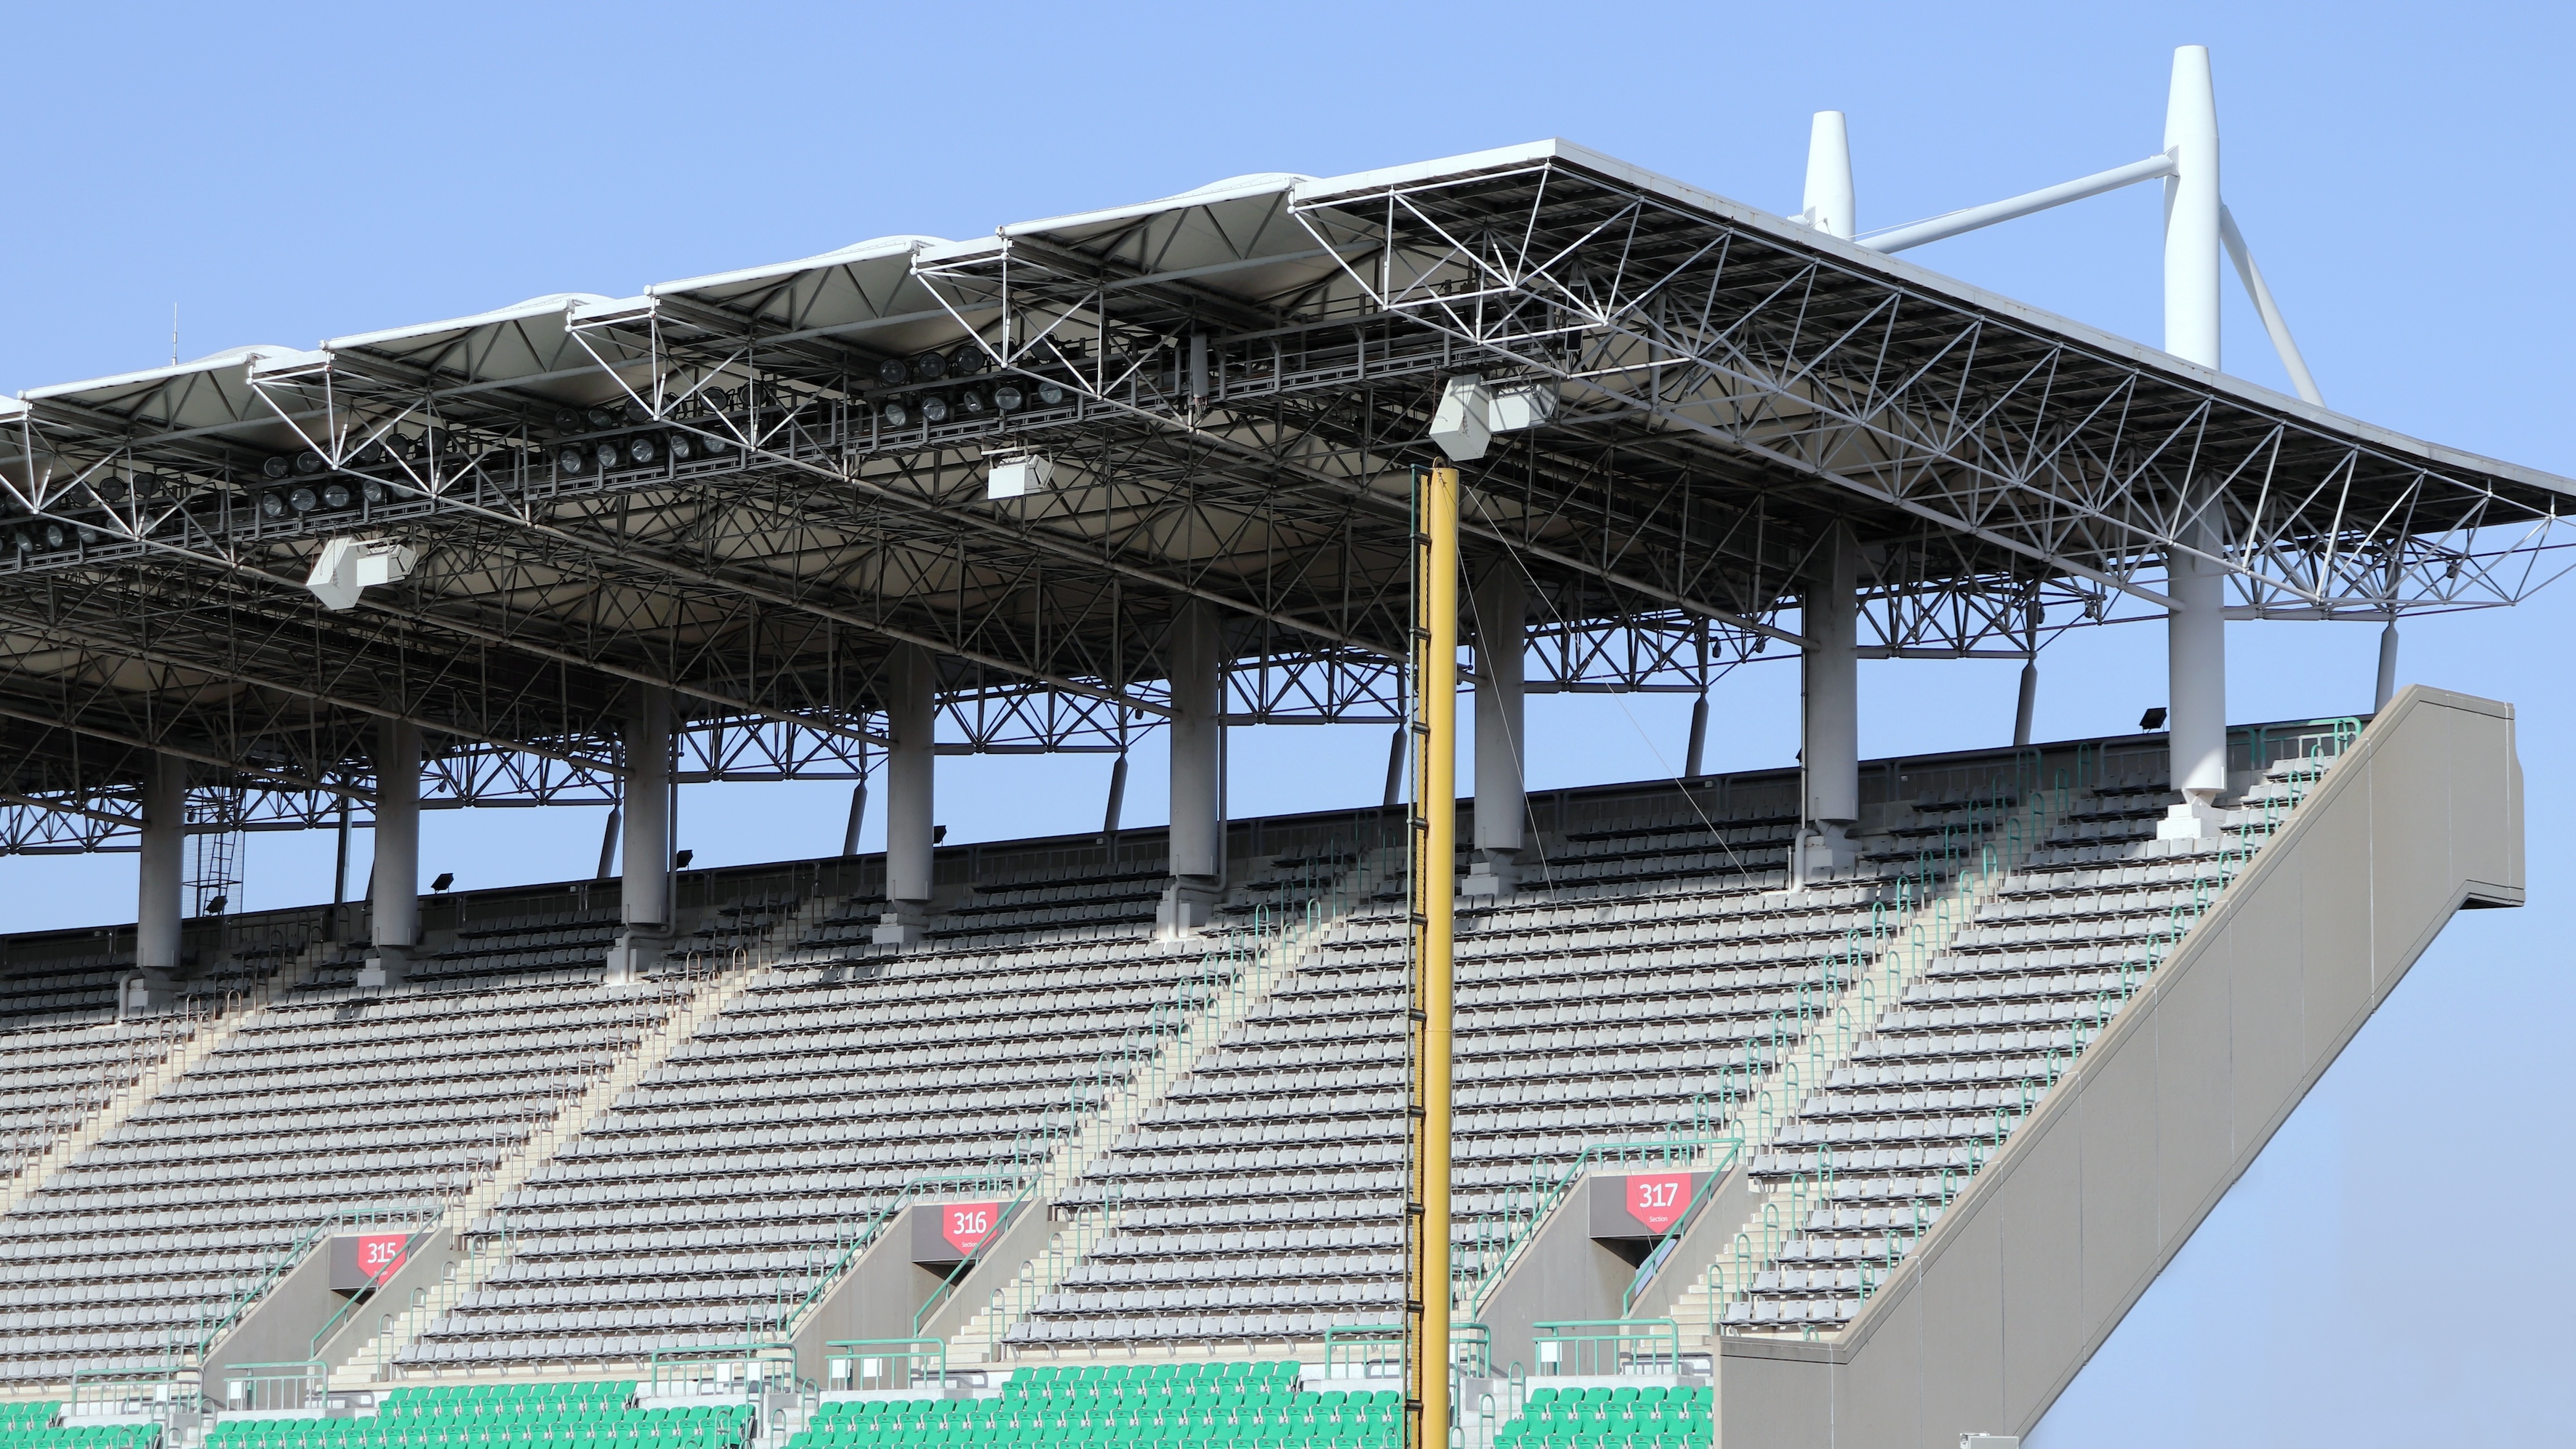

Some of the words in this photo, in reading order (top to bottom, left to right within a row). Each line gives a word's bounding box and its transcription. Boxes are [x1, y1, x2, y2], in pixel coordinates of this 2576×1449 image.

[1640, 1182, 1679, 1208] 317
[953, 1211, 987, 1235] 316
[367, 1241, 397, 1264] 315
